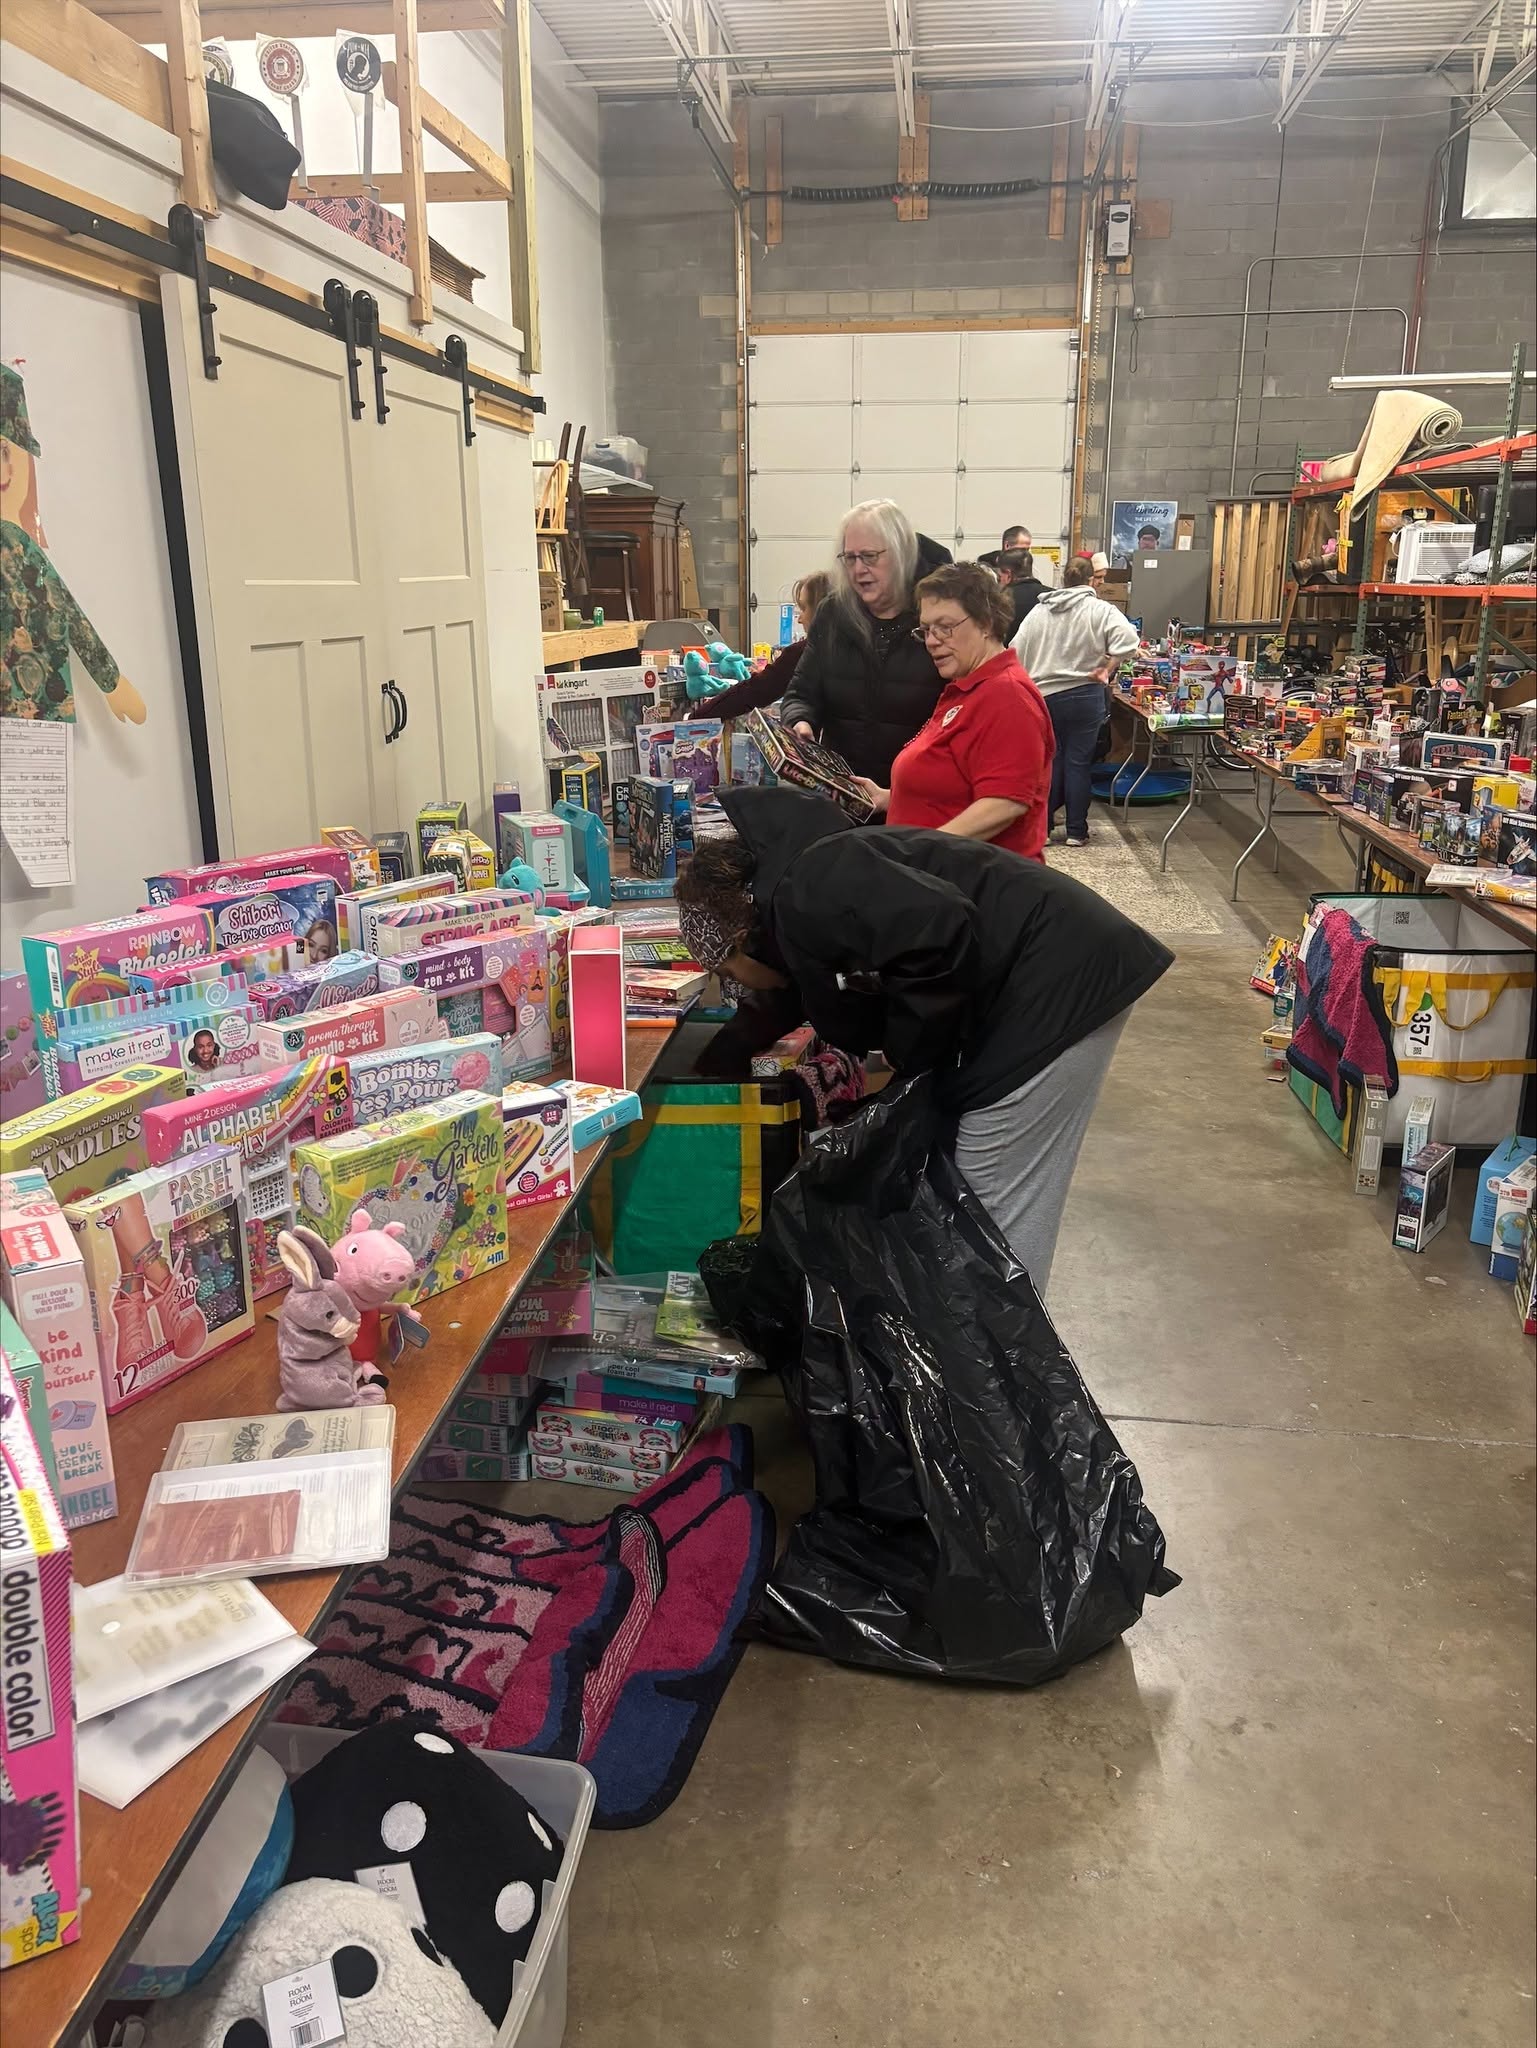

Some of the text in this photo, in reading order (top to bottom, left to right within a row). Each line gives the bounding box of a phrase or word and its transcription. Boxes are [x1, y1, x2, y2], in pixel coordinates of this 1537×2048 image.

[230, 901, 283, 930] Shibori
[445, 911, 496, 926] MAKE YOUR OWN
[129, 924, 196, 951] RAINBOW
[421, 914, 521, 946] STRING ART
[74, 952, 91, 966] Just
[118, 939, 204, 978] Bracelet
[157, 942, 270, 974] LUSCIOUS LAVA
[425, 961, 445, 975] mind
[453, 953, 472, 970] body
[77, 960, 101, 981] Style
[424, 976, 443, 990] zen
[308, 1019, 375, 1045] aroma therapy
[1410, 1012, 1432, 1046] 357
[85, 1036, 164, 1067] make it real
[87, 1061, 114, 1074] Bringing
[115, 1055, 144, 1068] Creativity
[358, 1058, 440, 1096] Bombs
[391, 1079, 460, 1104] Pour
[183, 1099, 282, 1152] ALPHABET
[184, 1115, 202, 1126] MINE
[320, 1118, 351, 1132] COLORFUL
[451, 1116, 476, 1141] My
[30, 1104, 134, 1161] Make Your Own Shaped
[38, 1114, 142, 1182] ANDLES
[432, 1132, 498, 1203] Garden
[168, 1157, 232, 1201] PASTEL
[170, 1175, 234, 1217] TASSEL
[516, 1192, 553, 1207] Gift for Girls!
[48, 1329, 69, 1344] be
[501, 1325, 541, 1336] RAINBO
[53, 1363, 74, 1375] to
[45, 1371, 96, 1390] ourself
[113, 1363, 141, 1399] 12
[619, 1399, 648, 1409] make
[656, 1403, 676, 1413] real
[58, 1450, 102, 1470] ESERVE
[60, 1443, 88, 1457] YOU
[64, 1461, 104, 1480] BREAK
[3, 1569, 39, 1740] double color
[377, 1878, 396, 1886] ROOM
[379, 1886, 397, 1894] ROOM
[288, 1983, 312, 1999] ROOM
[290, 1993, 313, 2008] ROOM
